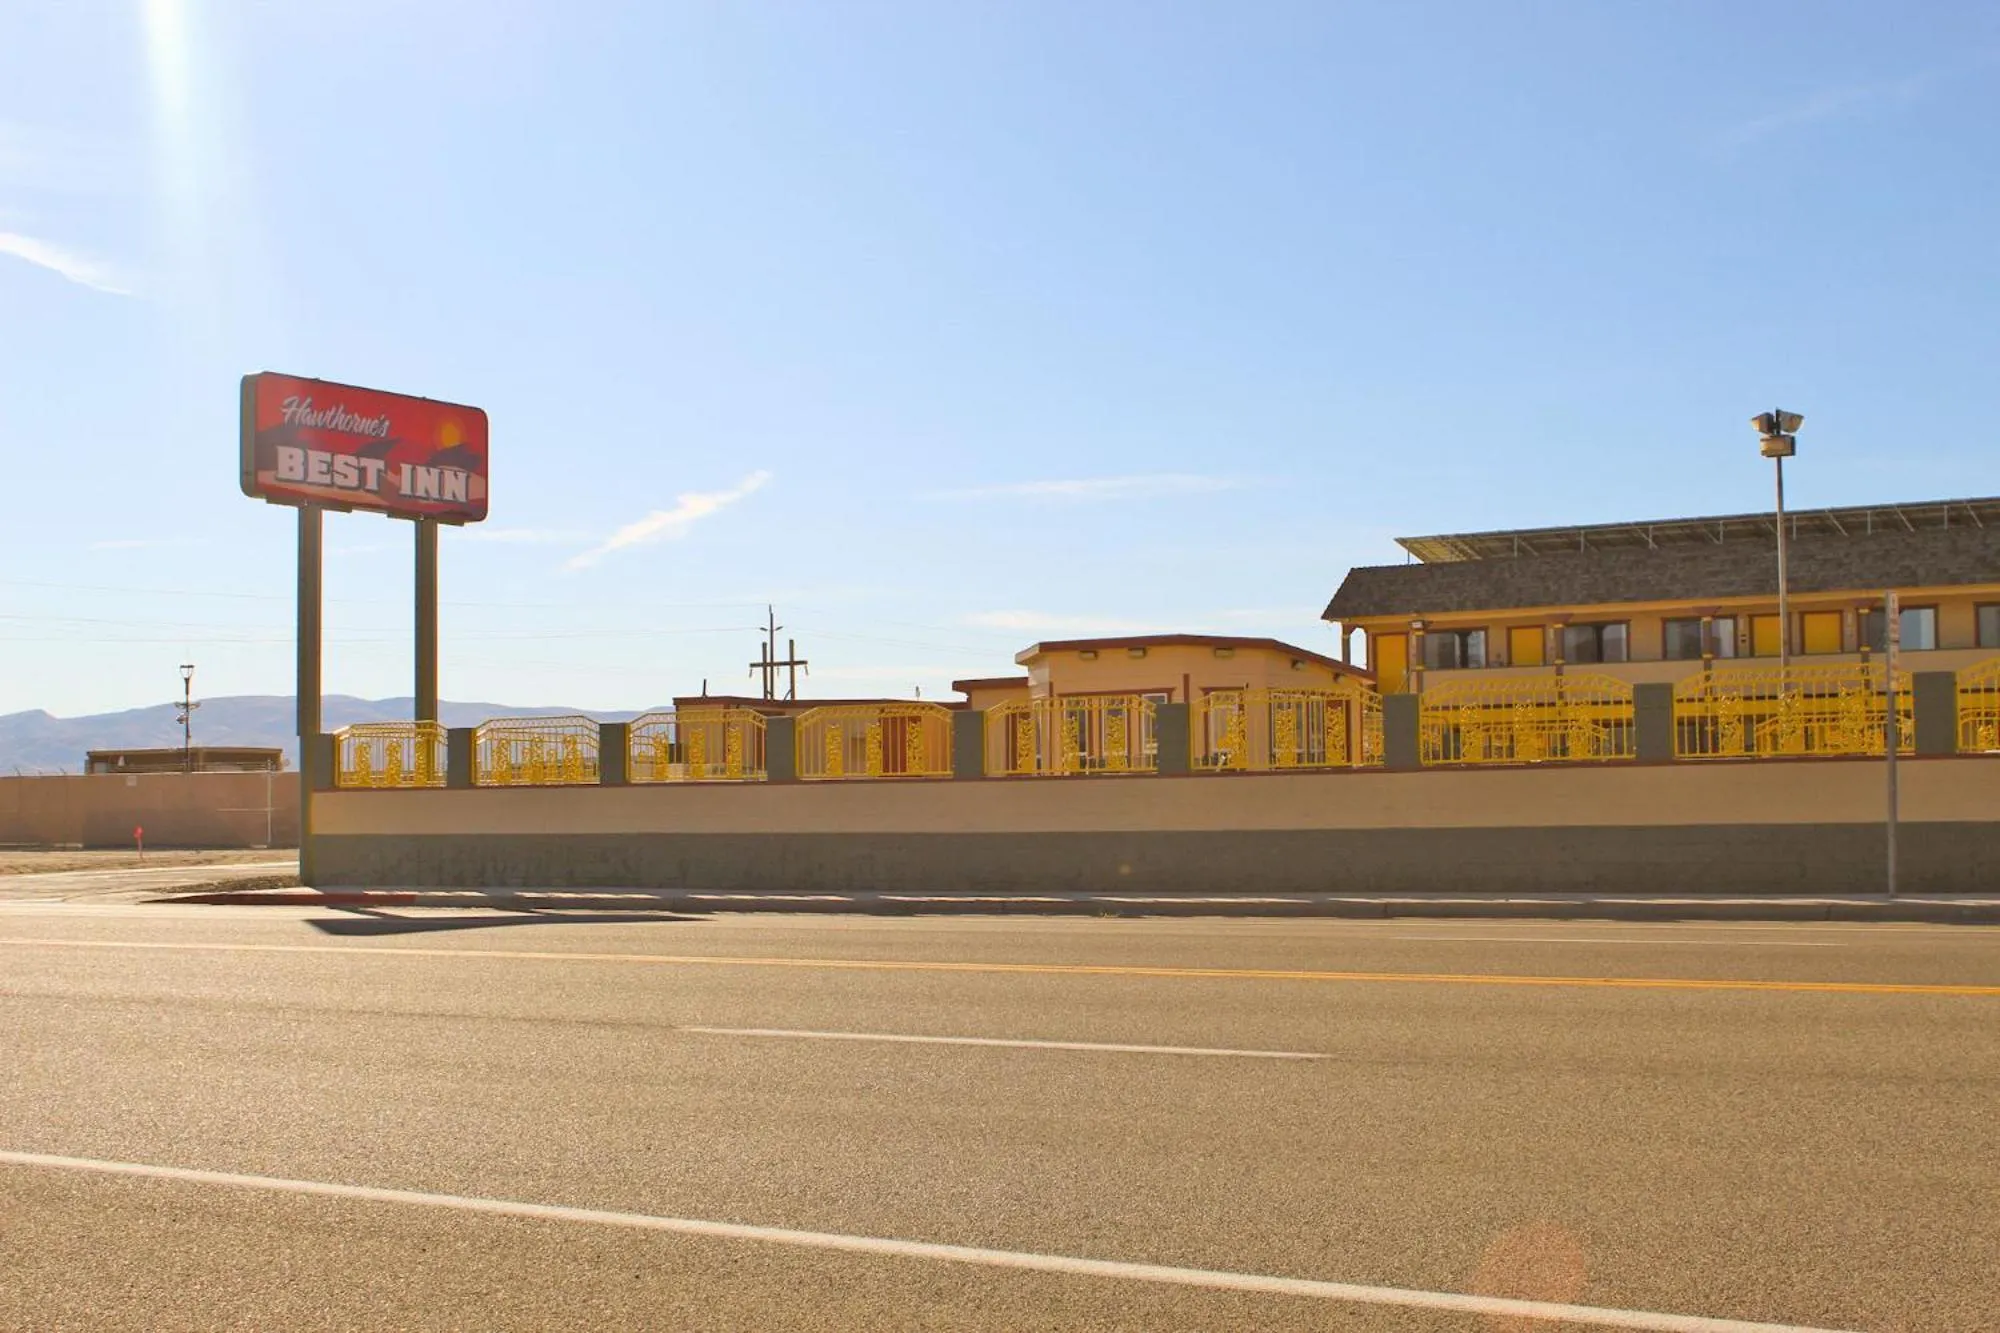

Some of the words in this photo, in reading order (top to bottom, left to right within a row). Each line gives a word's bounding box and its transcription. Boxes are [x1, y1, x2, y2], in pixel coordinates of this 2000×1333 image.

[282, 396, 390, 437] Hawthorne's
[276, 446, 385, 490] BEST
[399, 463, 468, 502] INN
